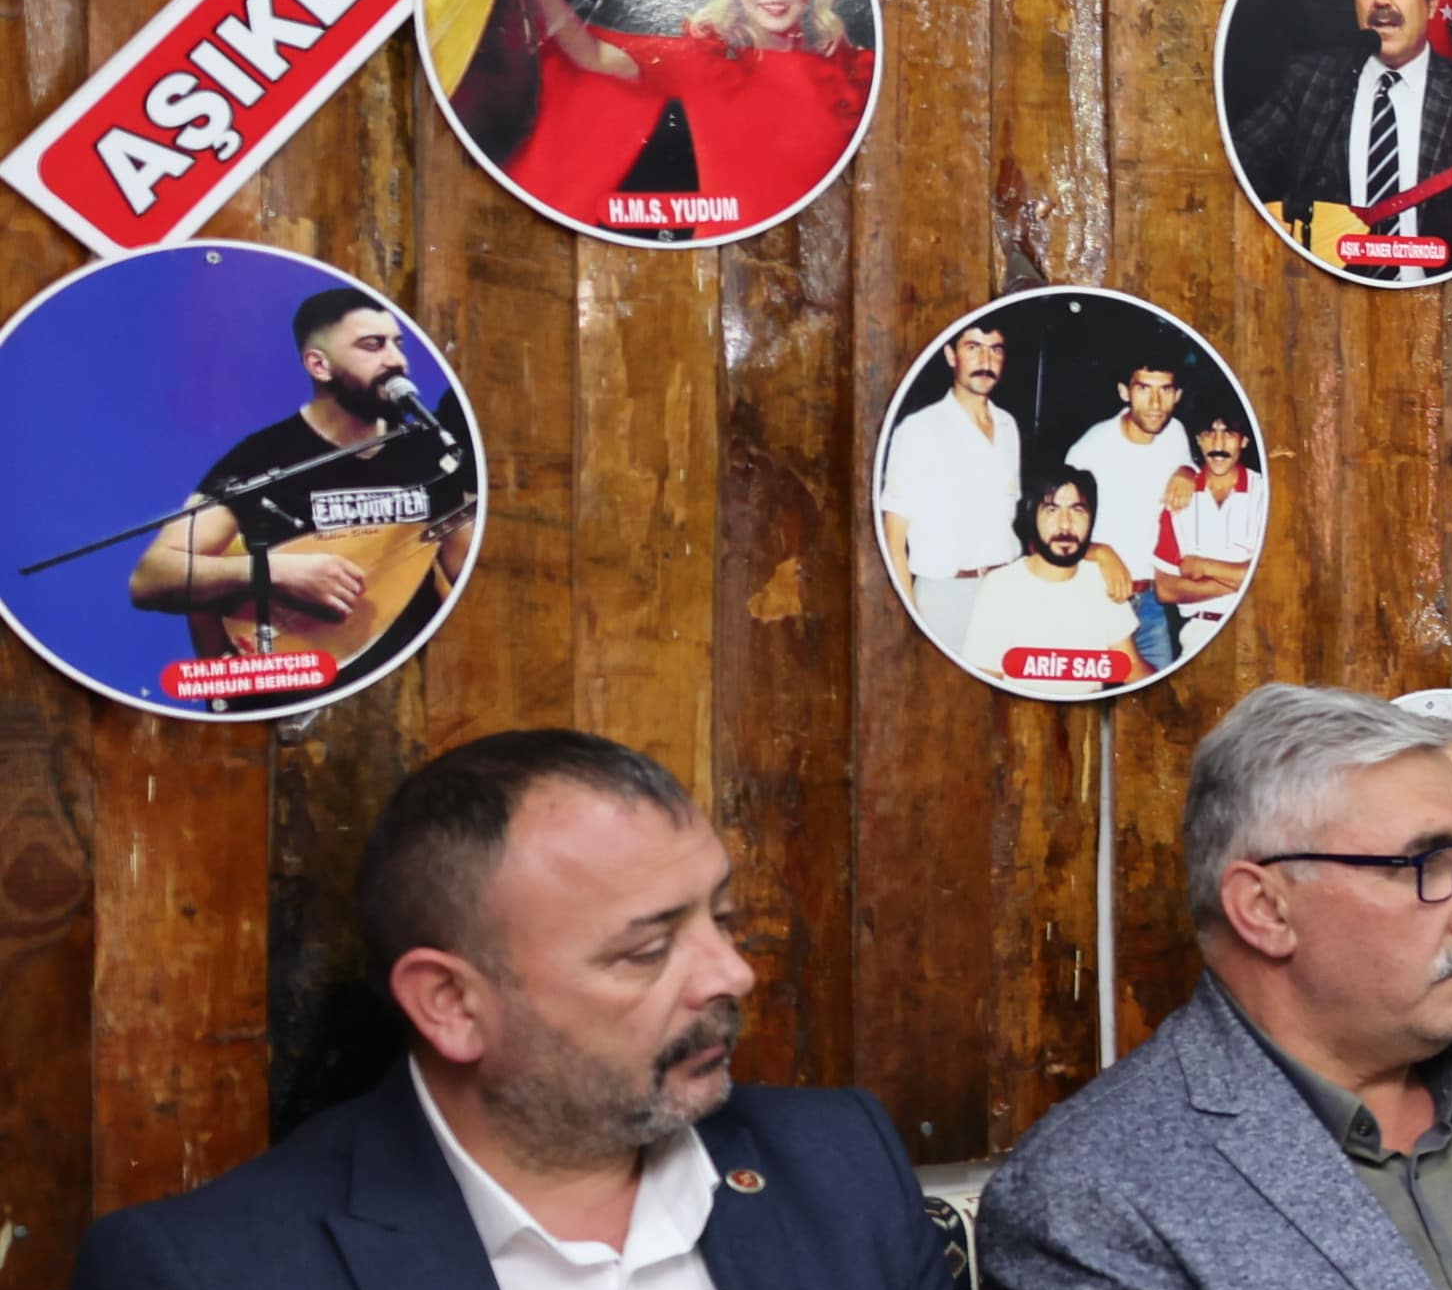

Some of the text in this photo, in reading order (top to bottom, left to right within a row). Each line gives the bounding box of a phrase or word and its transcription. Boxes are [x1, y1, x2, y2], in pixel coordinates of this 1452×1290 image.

[608, 196, 740, 224] H.M.S. YUDUM
[1022, 651, 1113, 679] ARİF SAĞ
[177, 679, 251, 697] MAHSUN
